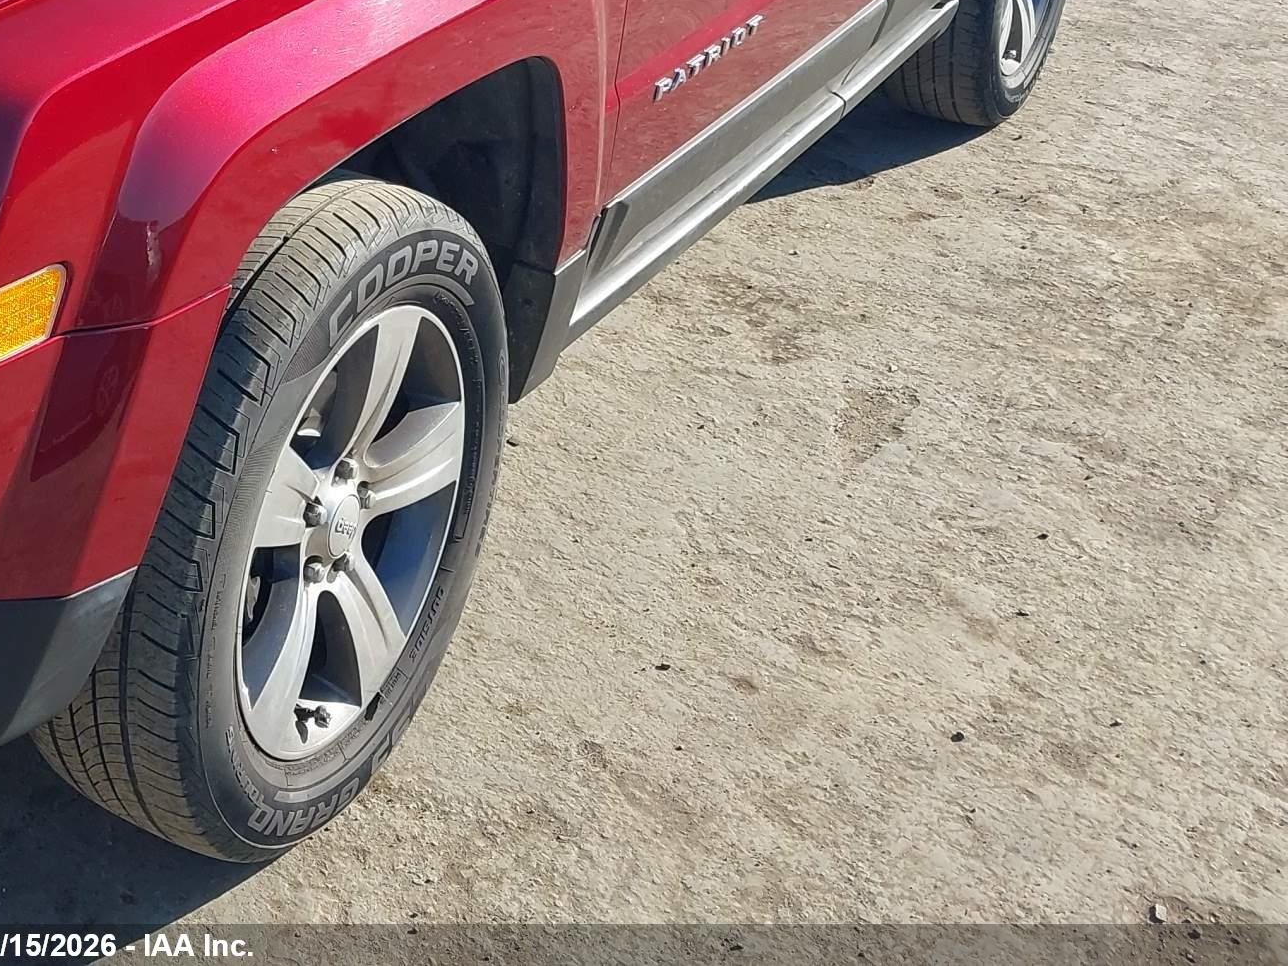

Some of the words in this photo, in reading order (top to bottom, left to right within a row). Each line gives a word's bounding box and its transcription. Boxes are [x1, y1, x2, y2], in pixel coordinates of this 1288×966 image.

[653, 13, 765, 102] PATRIOT
[328, 238, 480, 348] COOPER
[247, 777, 361, 837] GRAND
